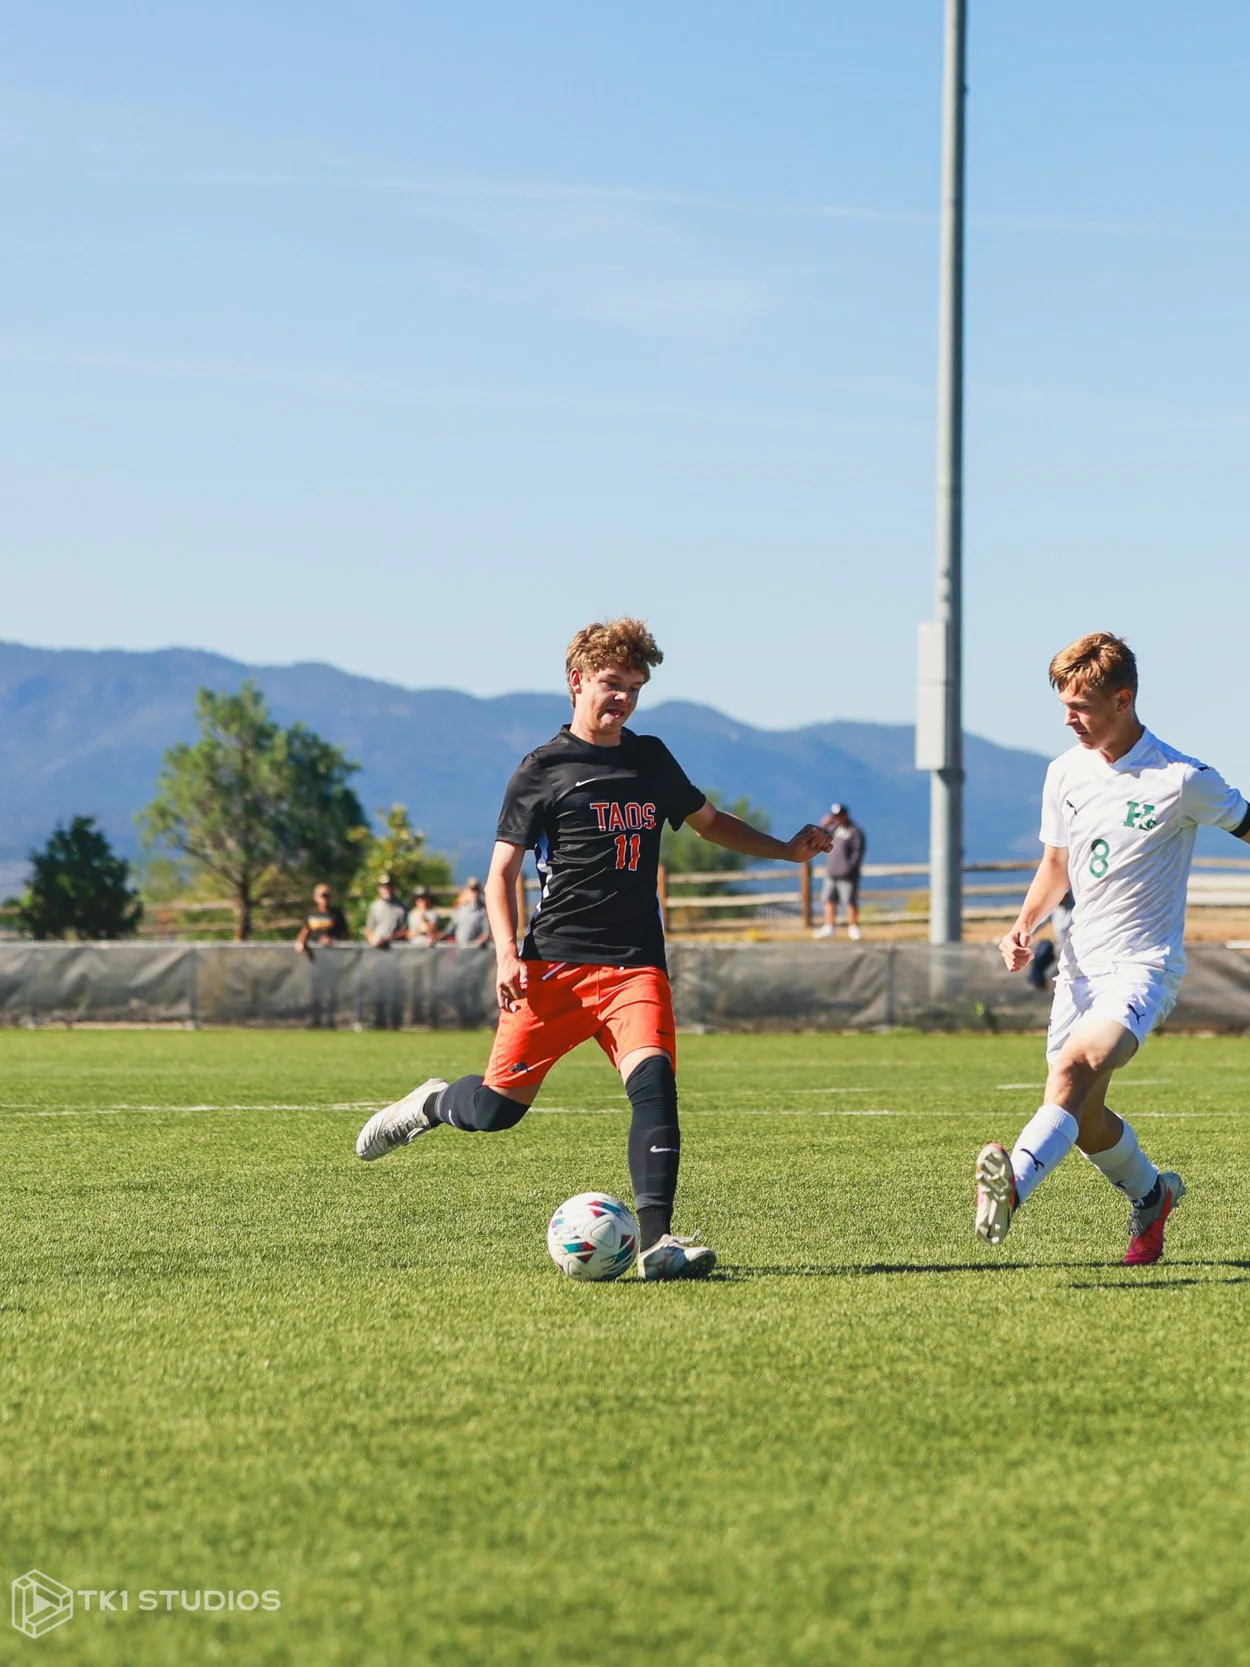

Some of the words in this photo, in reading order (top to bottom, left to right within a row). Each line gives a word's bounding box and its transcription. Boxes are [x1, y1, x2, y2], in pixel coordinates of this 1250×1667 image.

[589, 802, 656, 831] TAOS
[614, 833, 641, 871] 11
[1089, 839, 1110, 878] 8
